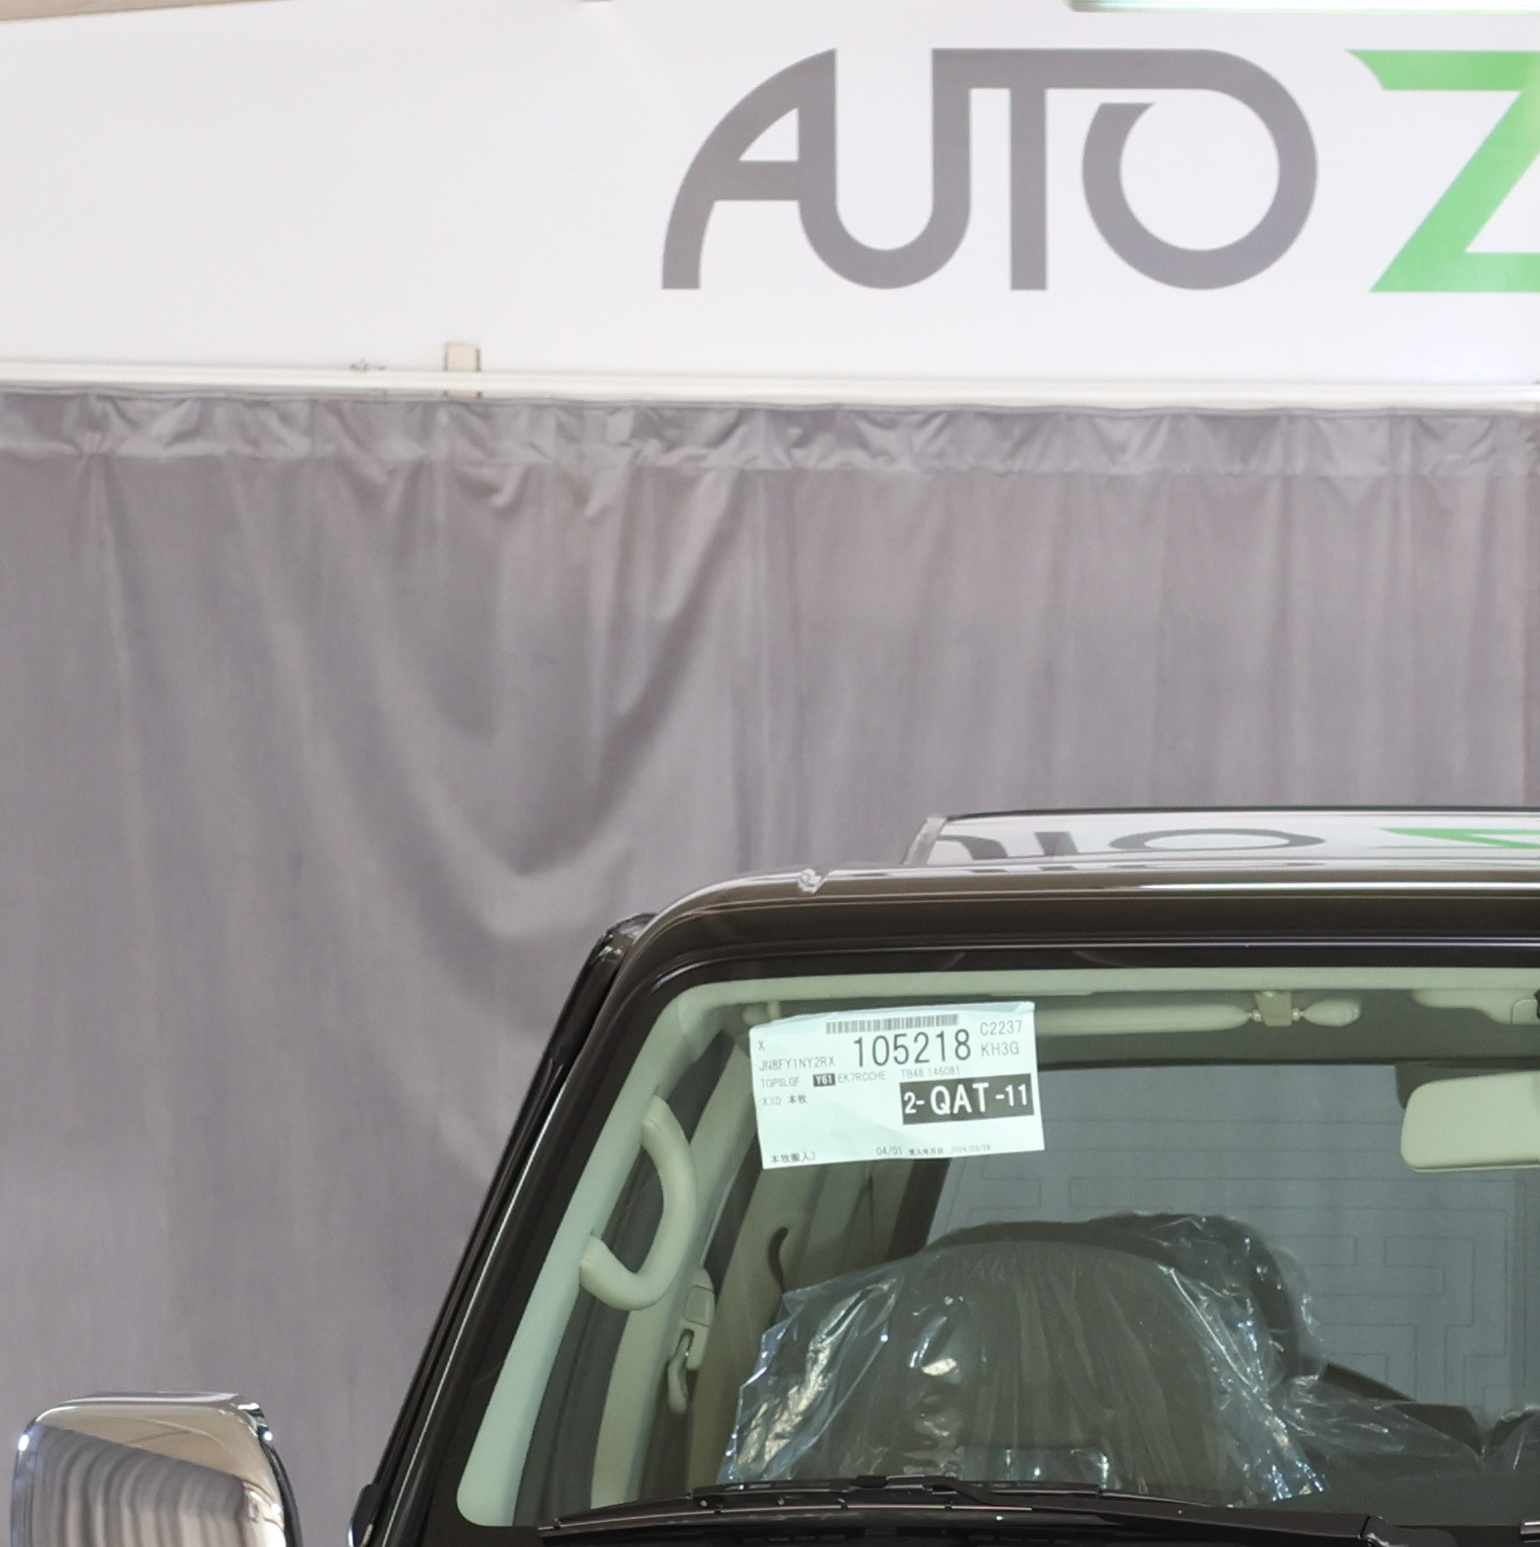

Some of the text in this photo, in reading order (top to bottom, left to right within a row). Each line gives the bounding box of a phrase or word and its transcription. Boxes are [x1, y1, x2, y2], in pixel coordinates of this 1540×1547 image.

[663, 49, 1317, 290] AUTO
[979, 1019, 1023, 1036] C2237
[853, 1028, 971, 1068] 105218
[981, 1041, 1020, 1057] KH3G
[815, 1074, 834, 1086] Y61
[900, 1068, 925, 1079] TB48
[876, 1146, 902, 1156] 04/01
